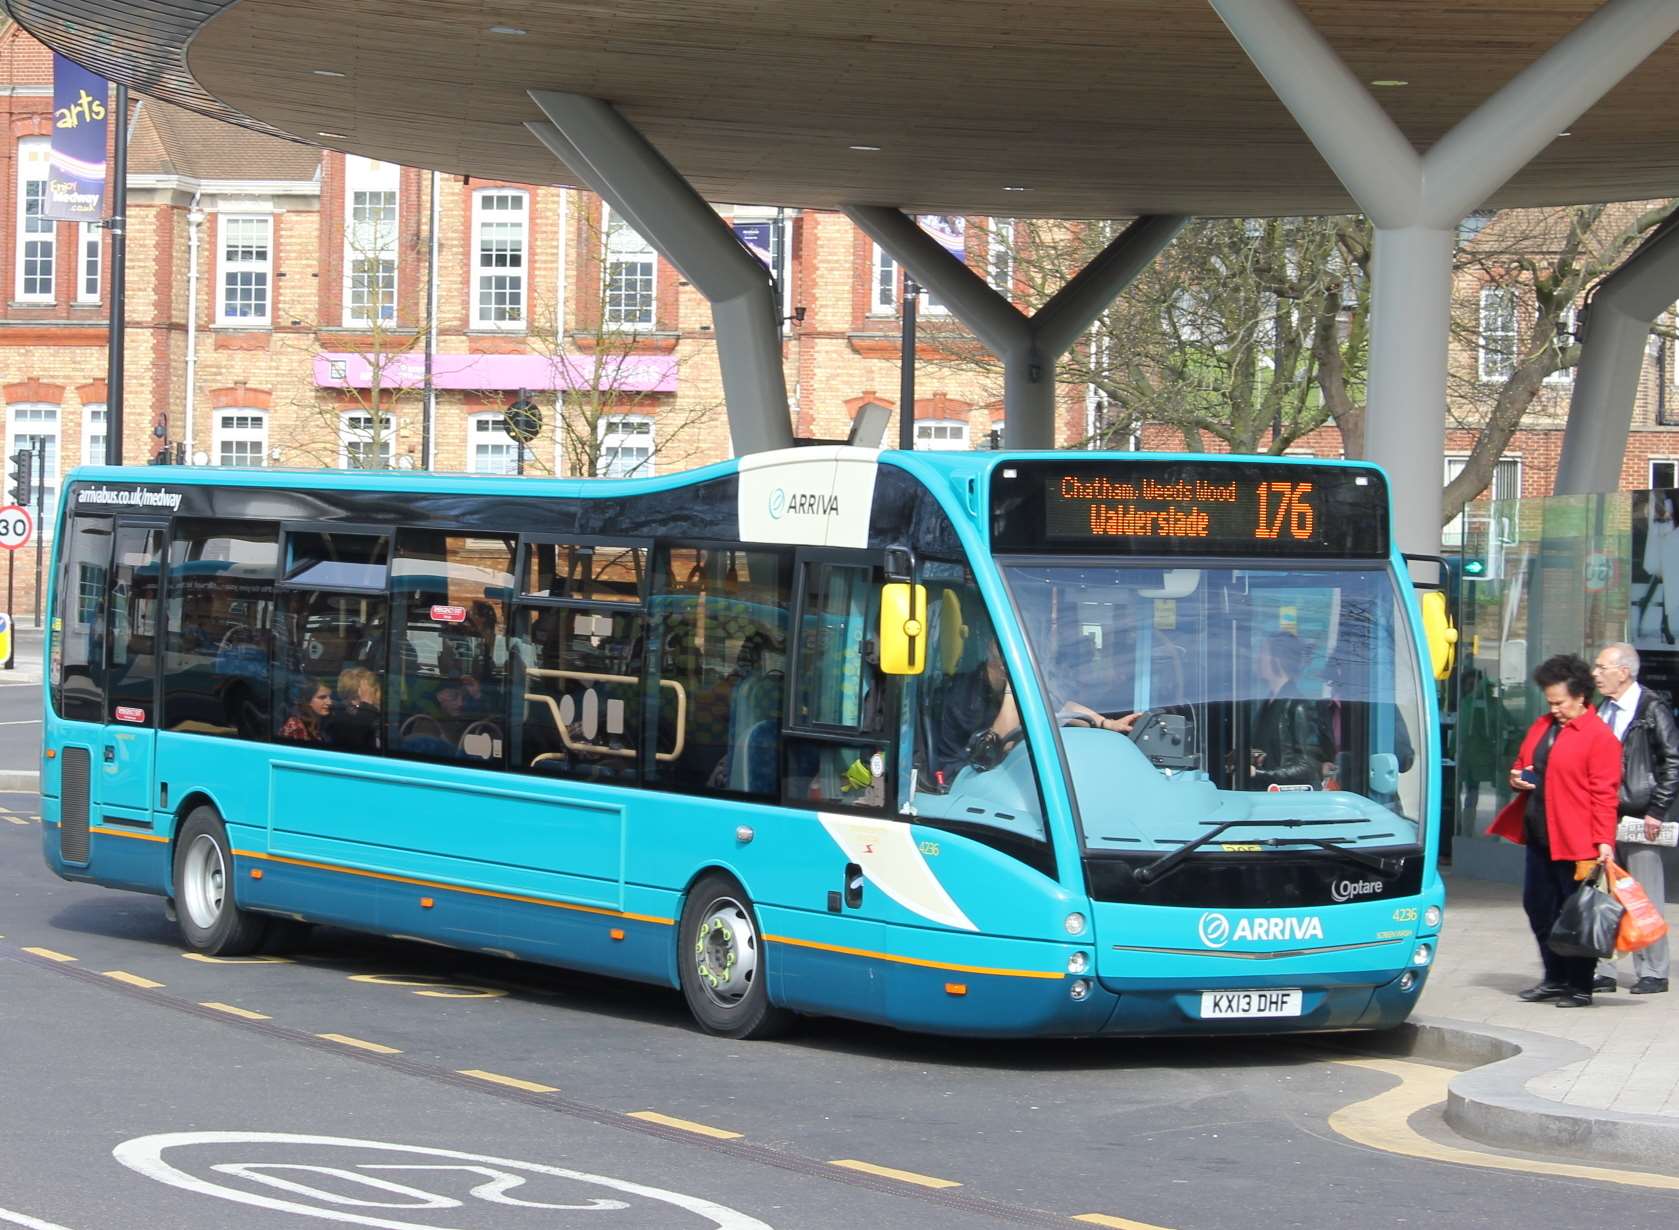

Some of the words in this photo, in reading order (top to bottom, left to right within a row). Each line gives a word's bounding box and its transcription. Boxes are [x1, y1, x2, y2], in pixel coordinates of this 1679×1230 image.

[54, 89, 106, 128] arts
[78, 486, 183, 512] arrivabus.co.uk/medway
[1143, 479, 1193, 501] Weeds
[1196, 480, 1236, 502] Wood
[786, 493, 840, 516] ARRIVA
[1255, 481, 1314, 539] 176
[0, 519, 27, 537] 30
[1089, 504, 1209, 537] Walderslade
[919, 841, 940, 856] 4236
[1336, 879, 1383, 900] Optare
[1392, 907, 1418, 922] 4236
[1232, 916, 1324, 941] ARRIVA
[1212, 994, 1252, 1014] KX13
[1257, 993, 1291, 1013] DHF
[210, 1162, 630, 1211] 20
